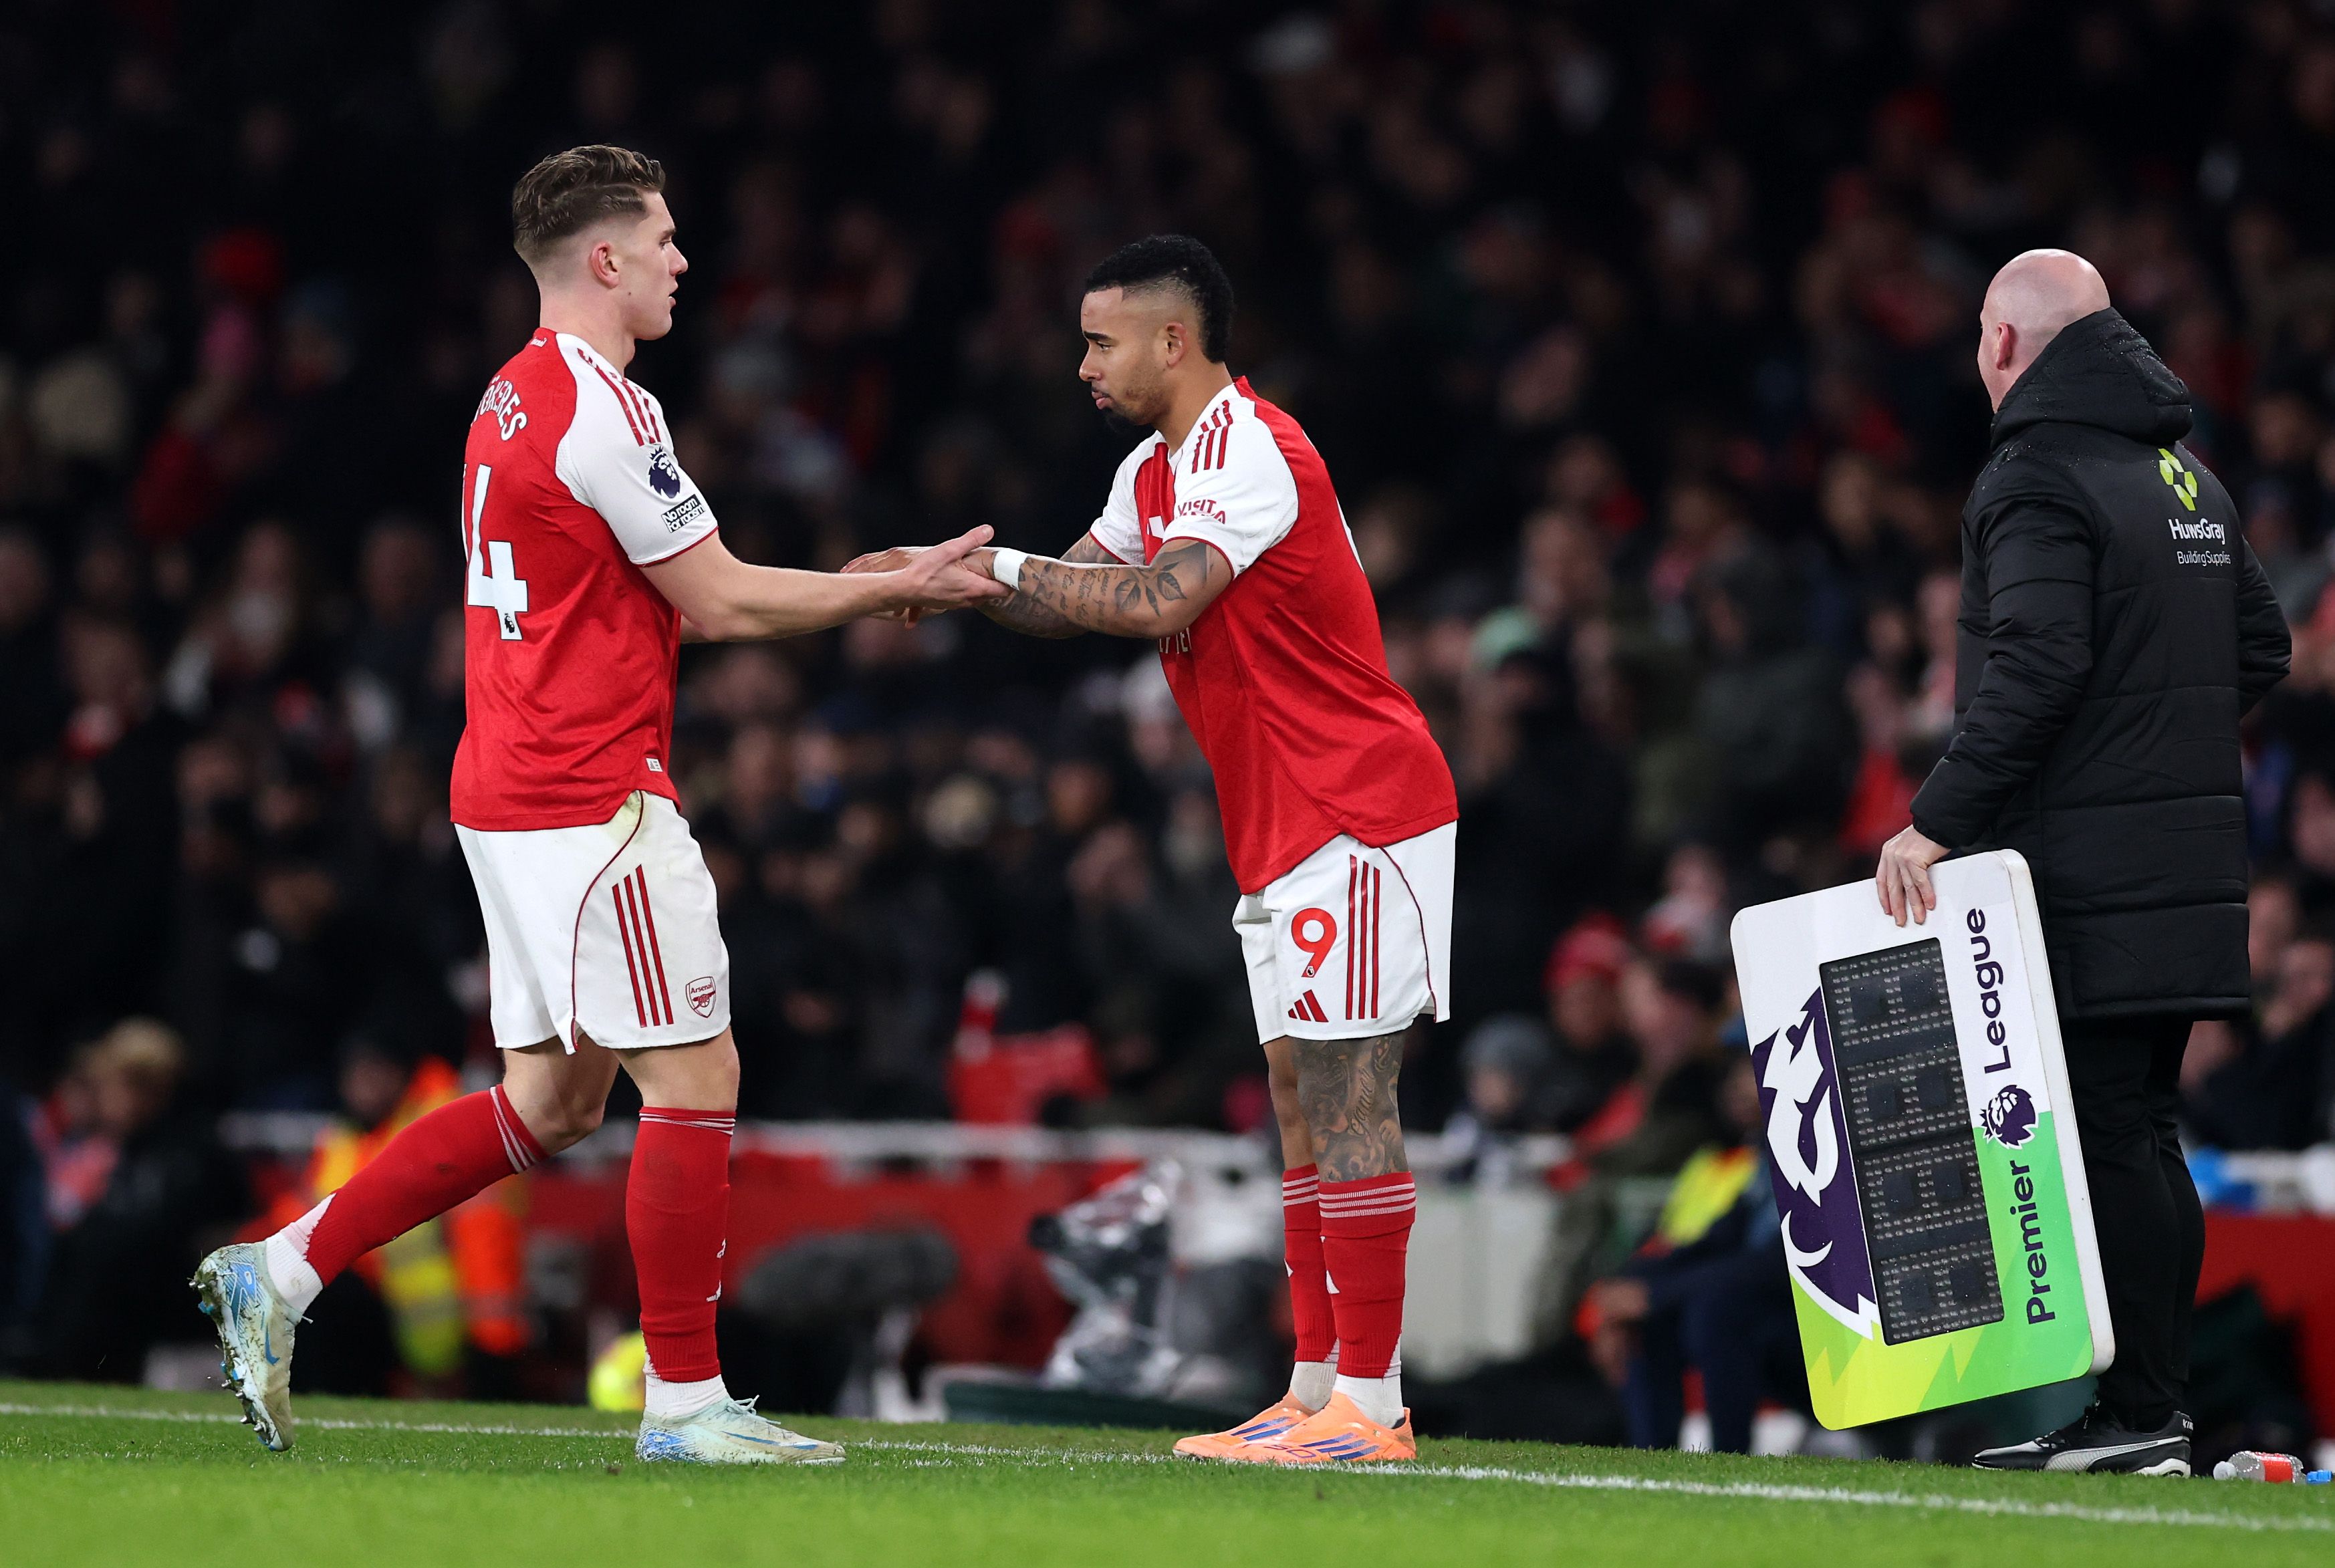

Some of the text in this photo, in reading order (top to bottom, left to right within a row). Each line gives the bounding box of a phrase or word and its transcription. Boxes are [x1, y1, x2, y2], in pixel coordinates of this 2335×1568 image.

[661, 498, 698, 525] No room
[680, 504, 705, 525] racism
[1178, 499, 1217, 517] VISIT
[2168, 518, 2225, 545] HuwsGray
[461, 463, 528, 641] 4
[2177, 550, 2231, 567] Building Supplies
[1291, 908, 1337, 978] 9
[1967, 908, 2056, 1325] Premier League
